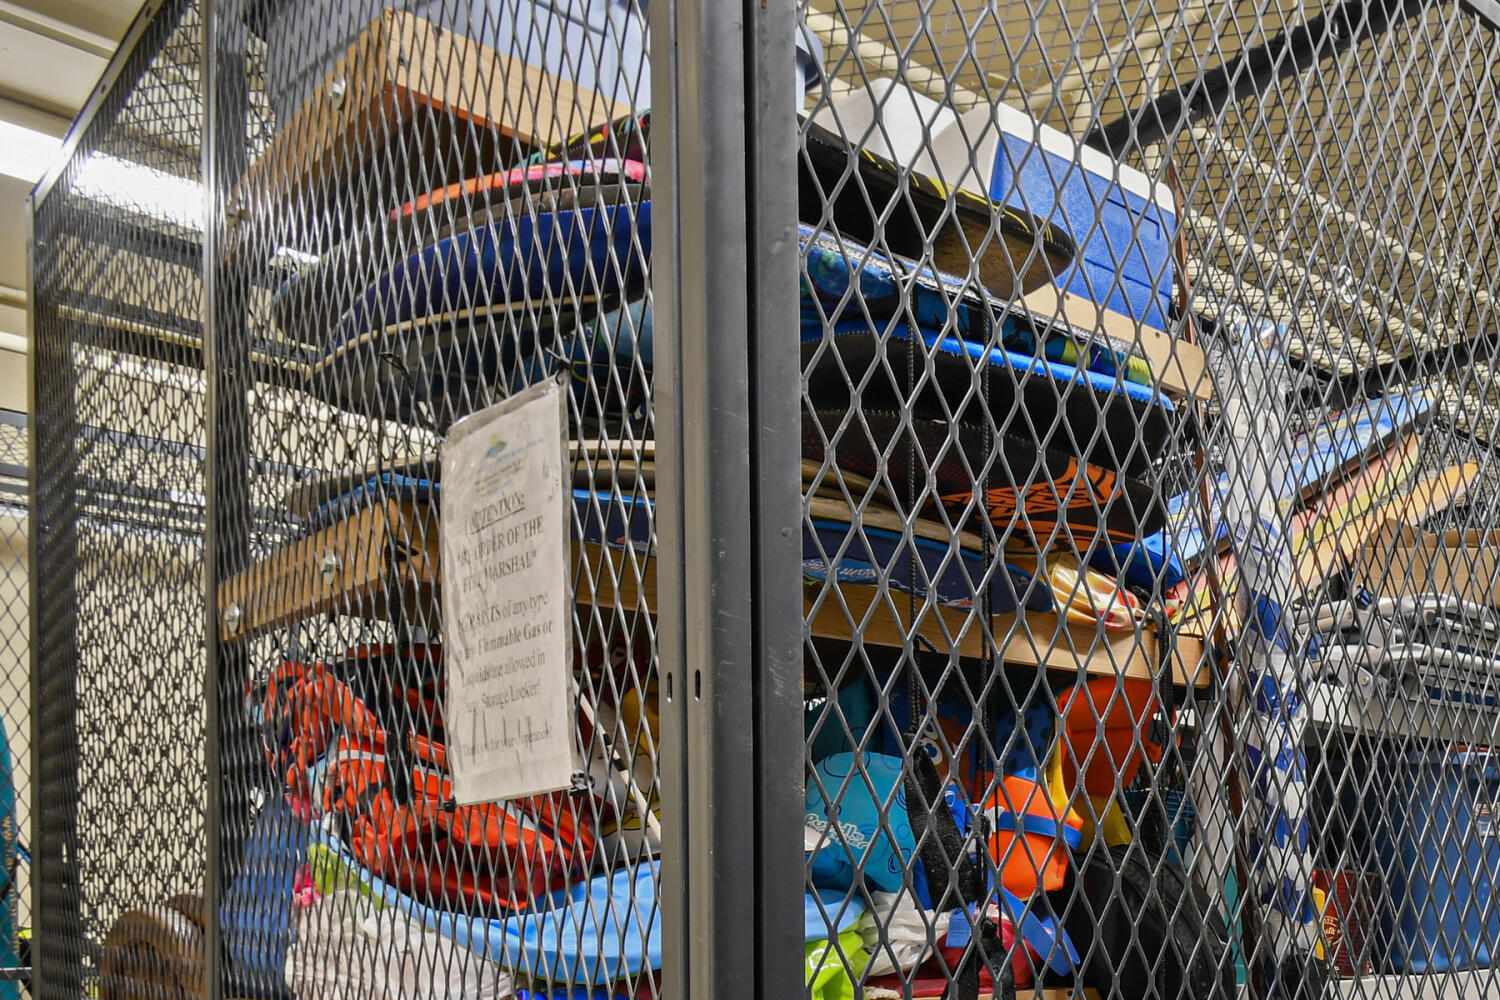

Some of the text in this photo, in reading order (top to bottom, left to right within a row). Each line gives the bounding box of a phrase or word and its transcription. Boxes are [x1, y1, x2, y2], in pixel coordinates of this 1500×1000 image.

[507, 526, 521, 546] OF
[523, 515, 544, 540] THE
[502, 599, 512, 618] of
[512, 599, 528, 617] any
[529, 592, 549, 613] type
[523, 621, 541, 641] Gas
[543, 620, 554, 634] or
[505, 650, 536, 676] allowed
[537, 648, 546, 665] in
